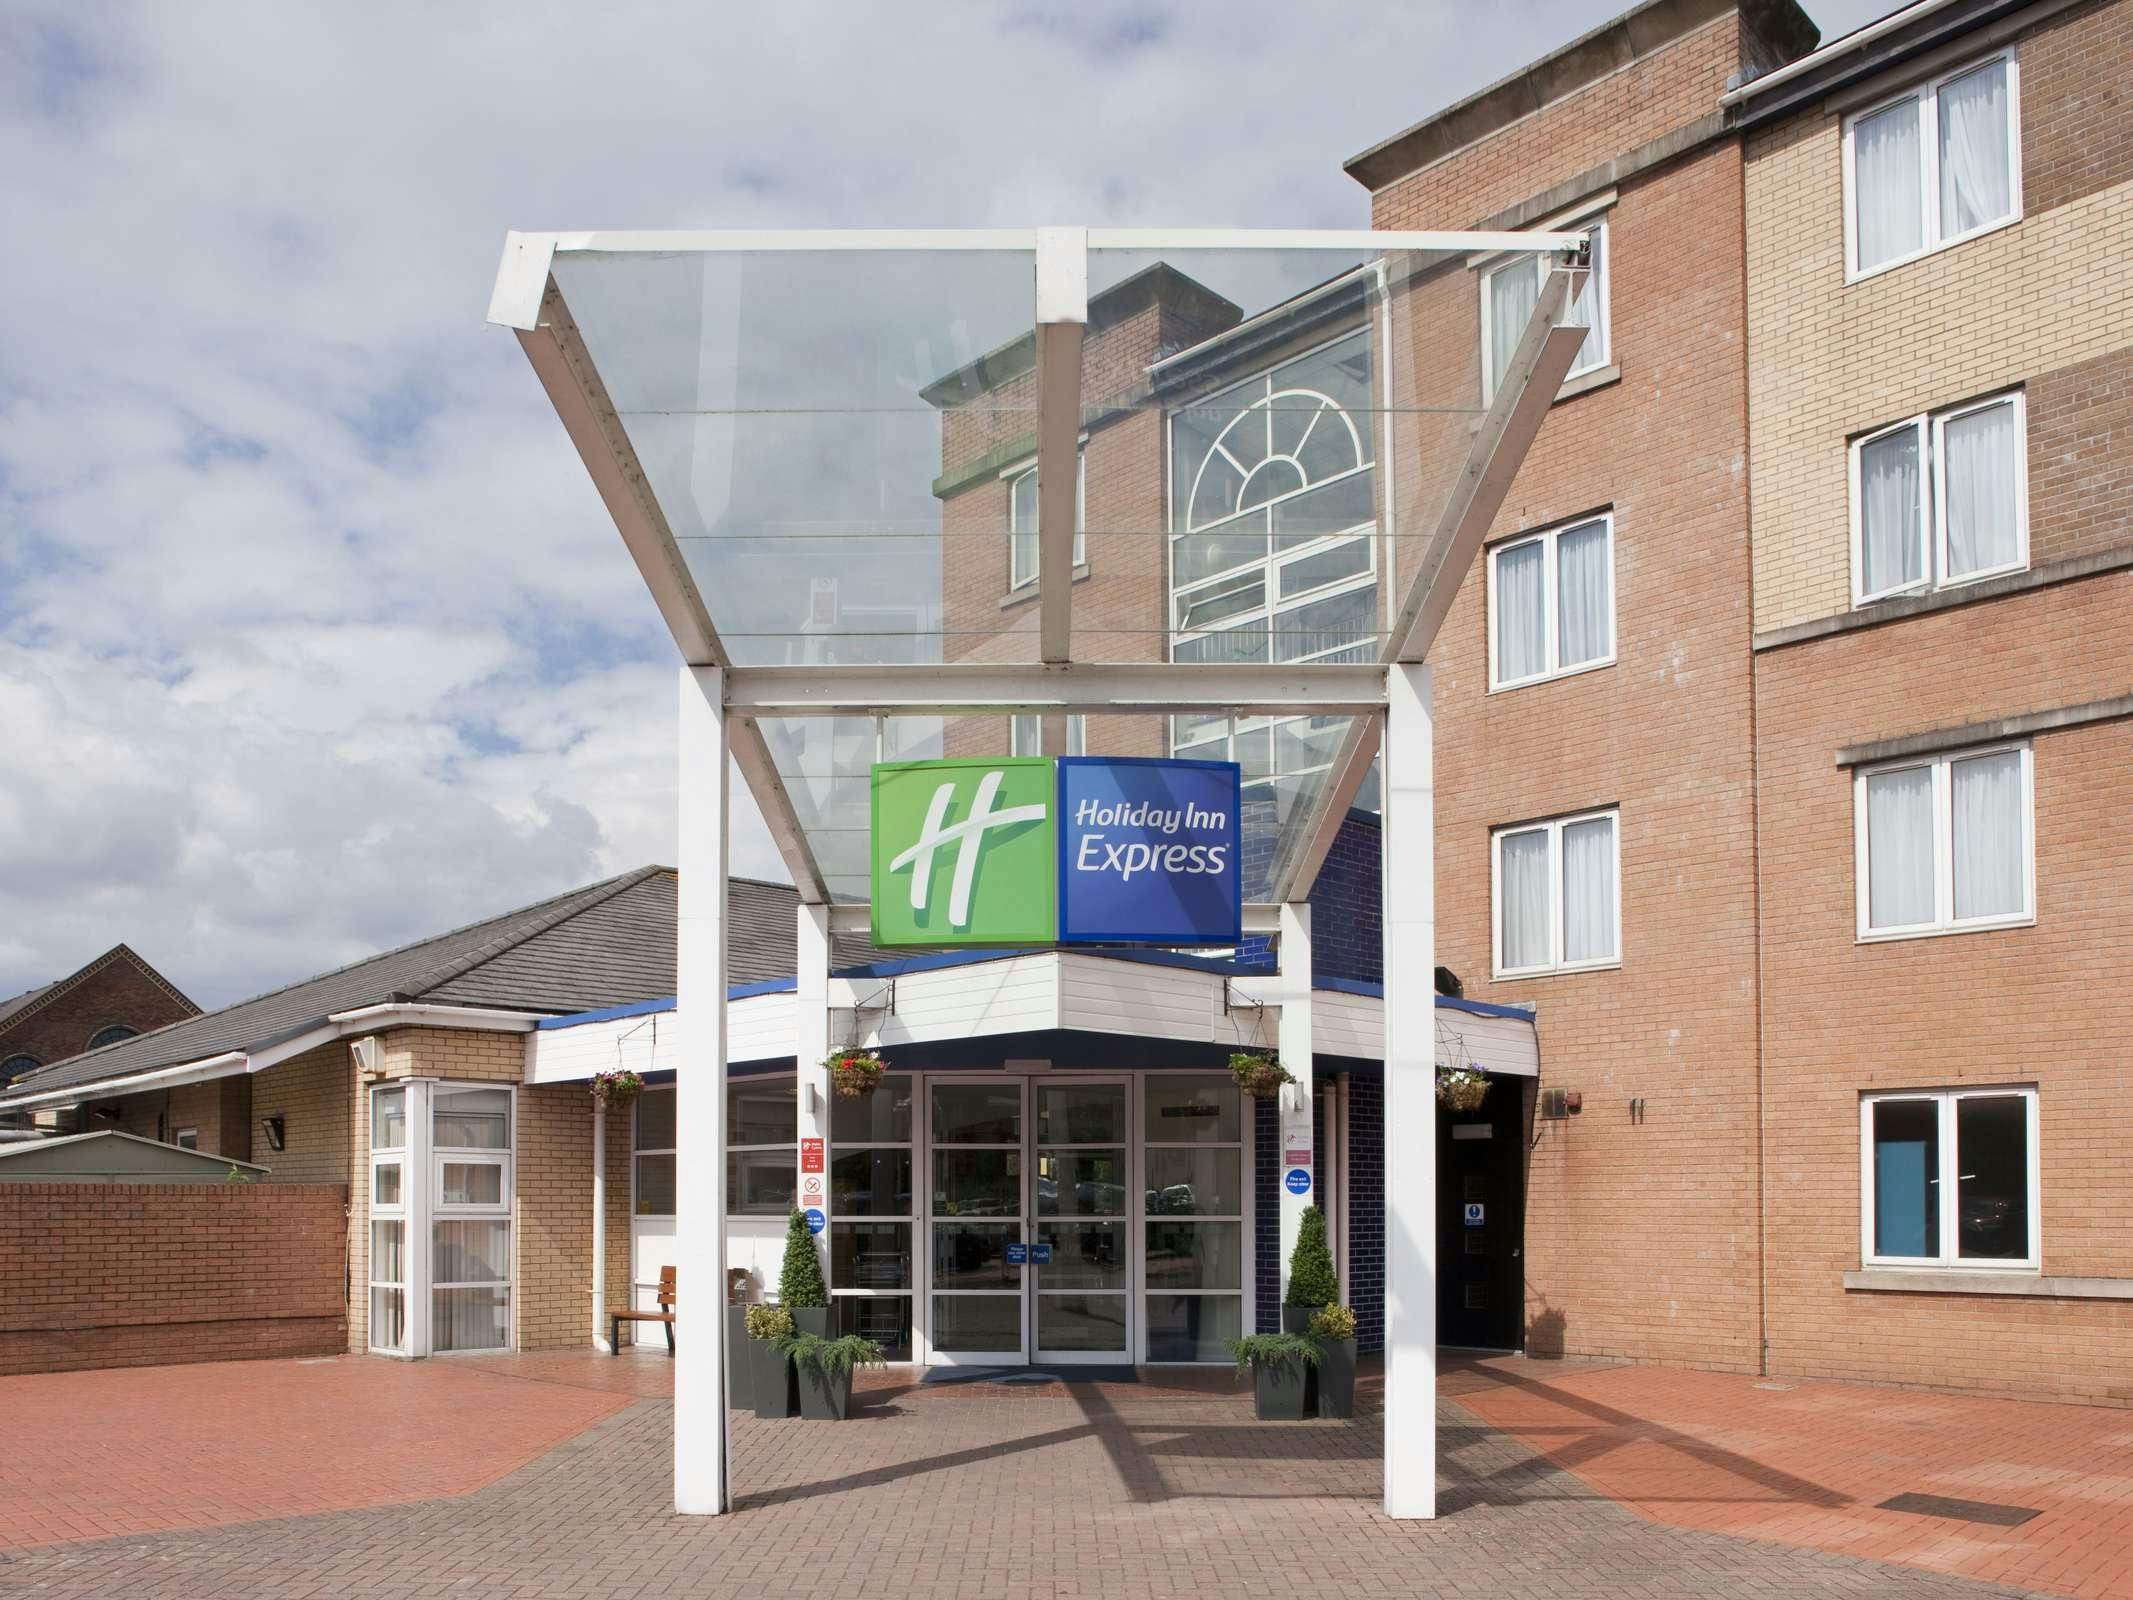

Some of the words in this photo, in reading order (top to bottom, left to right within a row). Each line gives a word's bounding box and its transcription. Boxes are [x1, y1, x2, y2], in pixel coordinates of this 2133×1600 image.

[1076, 799, 1181, 834] Holiday
[1185, 802, 1226, 829] Inn
[1077, 834, 1227, 881] Express
